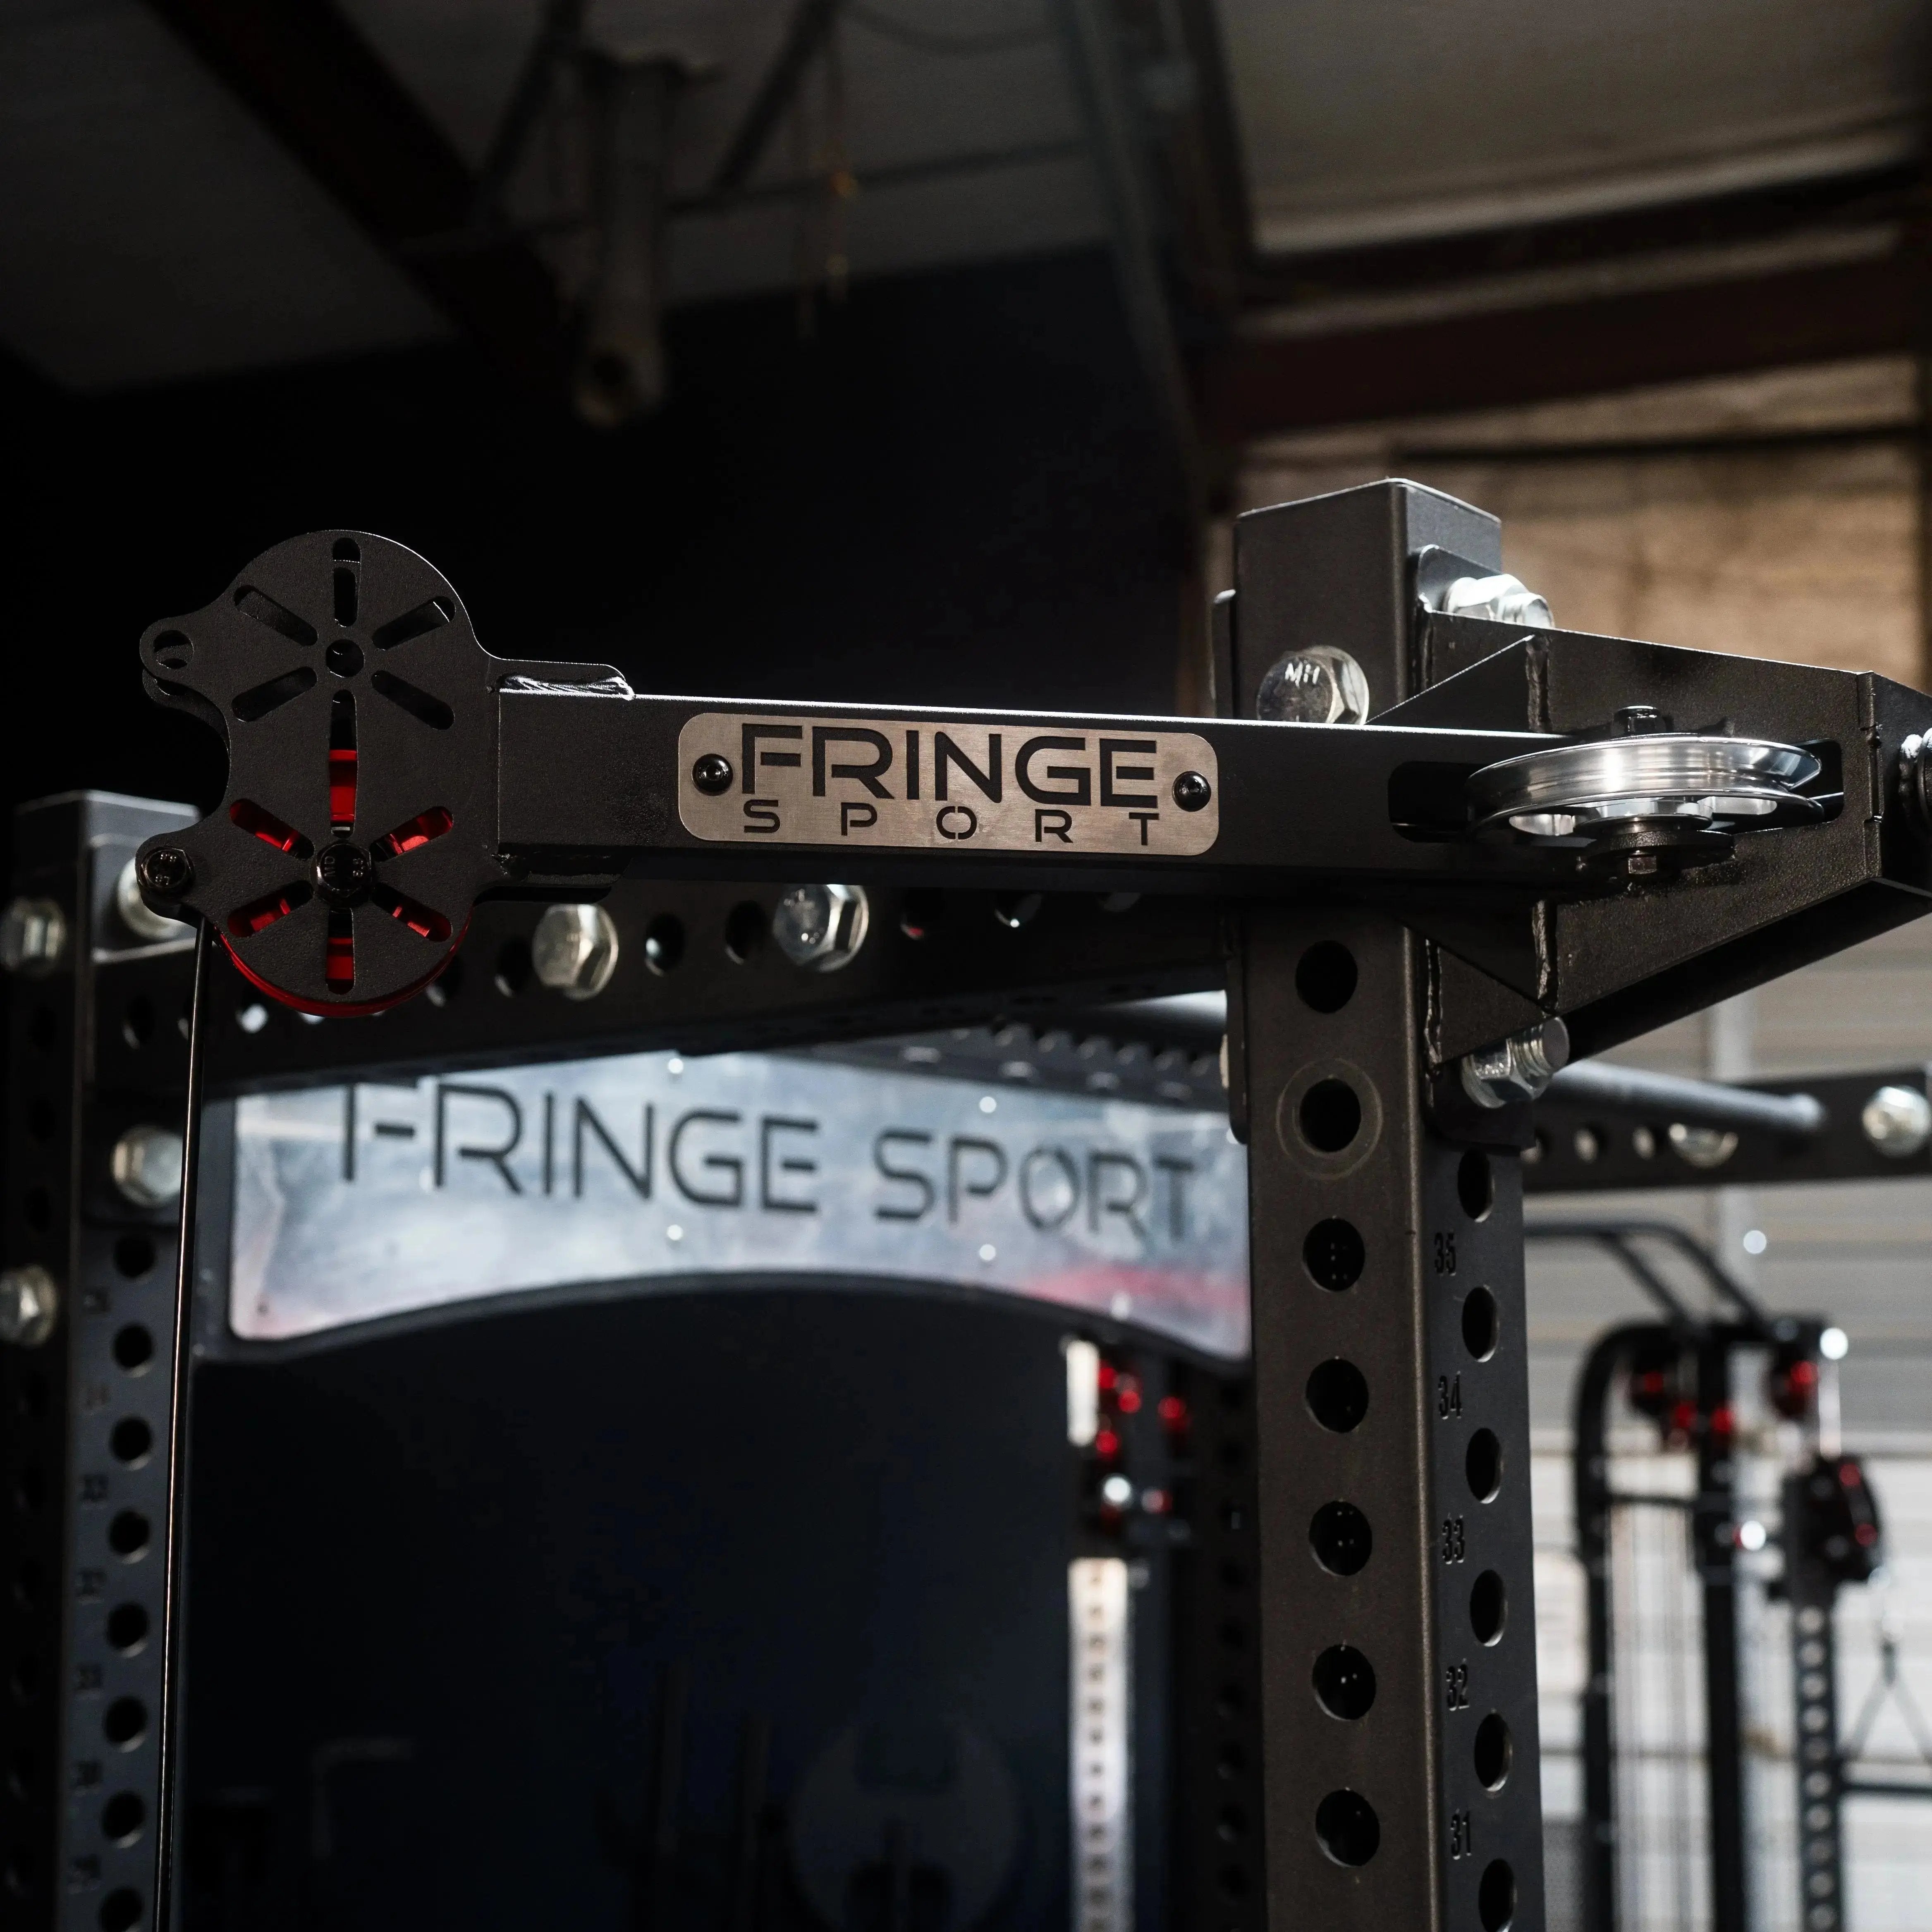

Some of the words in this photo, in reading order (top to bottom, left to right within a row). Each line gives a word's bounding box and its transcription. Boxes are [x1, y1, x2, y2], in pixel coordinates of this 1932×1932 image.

[742, 723, 1158, 808] FRINGE
[744, 799, 1160, 846] SPORT
[342, 1082, 818, 1212] FRINGE
[873, 1127, 1193, 1241] SPORT
[1434, 1231, 1456, 1276] 35
[1438, 1371, 1462, 1419] 34
[1442, 1516, 1464, 1564] 33
[1446, 1662, 1469, 1711] 32
[1450, 1811, 1471, 1860] 31
